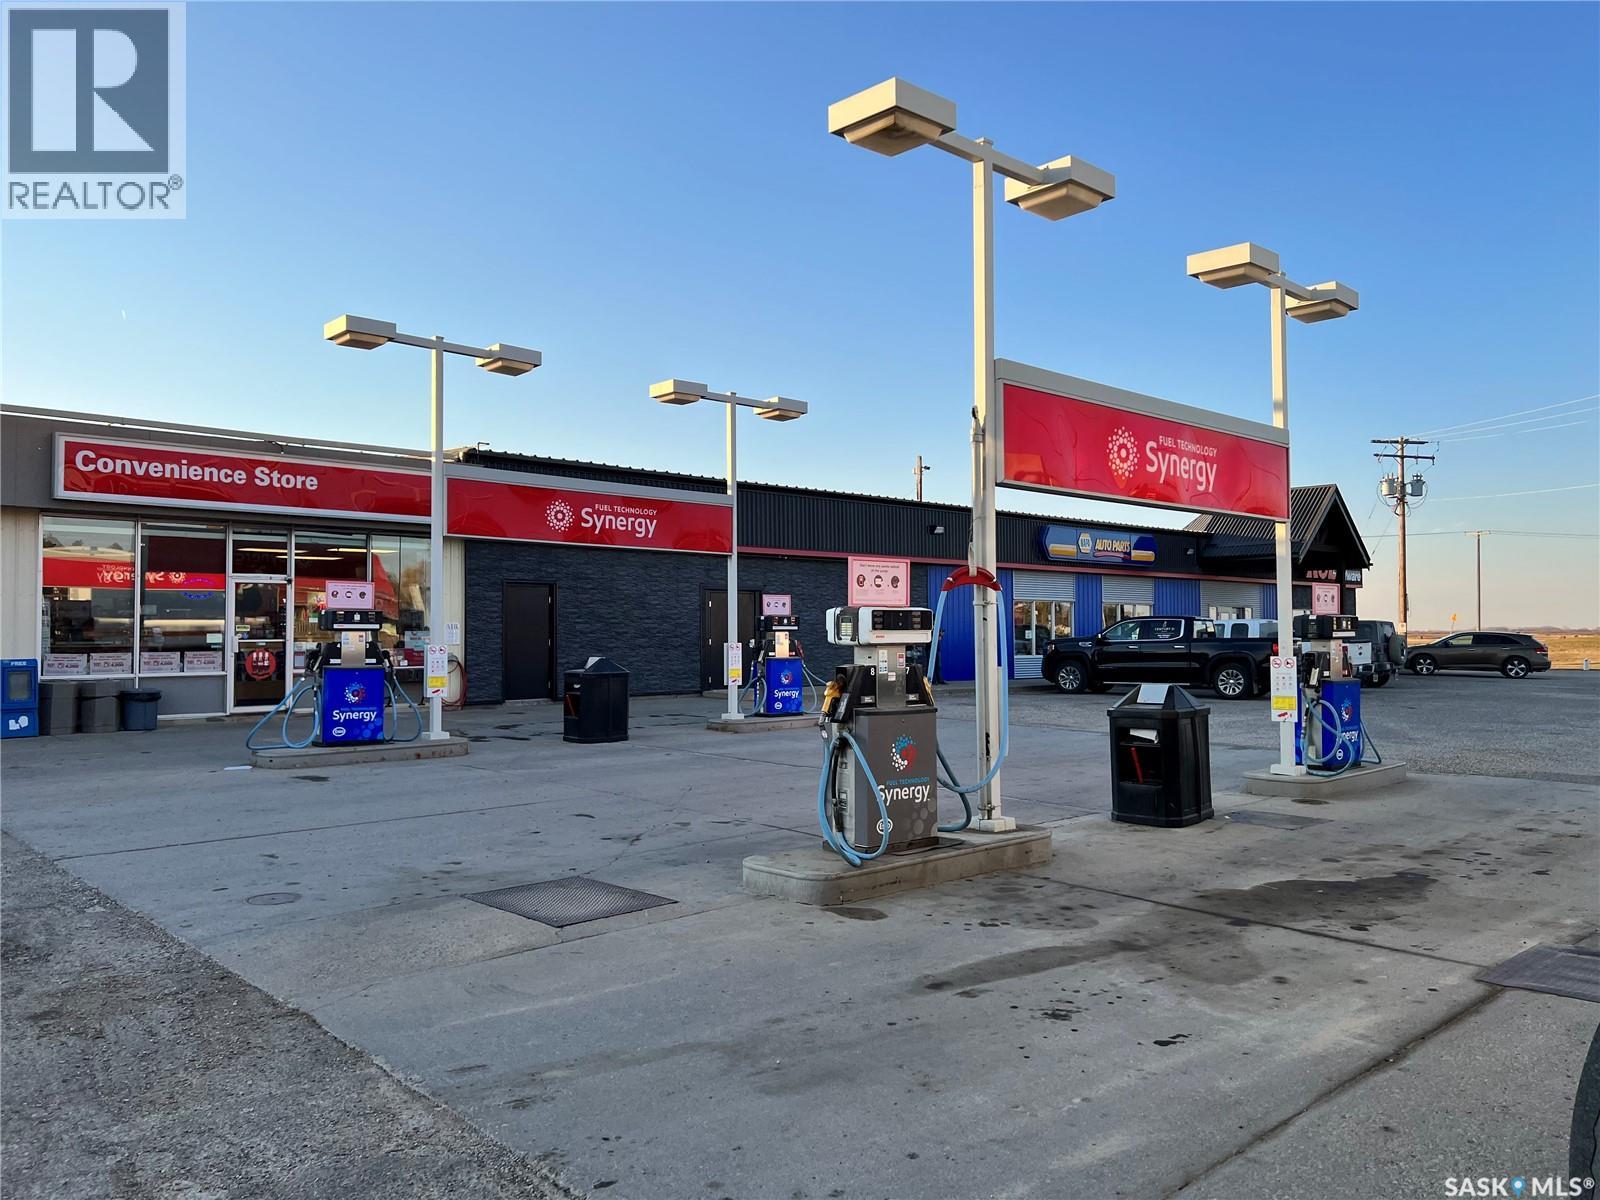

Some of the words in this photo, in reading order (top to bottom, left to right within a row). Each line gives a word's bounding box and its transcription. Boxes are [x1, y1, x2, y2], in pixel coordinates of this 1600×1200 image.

[1159, 435, 1176, 448] FUEL
[1177, 439, 1217, 457] TECHNOLOGY
[75, 450, 247, 485] Convenience
[254, 466, 318, 490] Store
[1146, 440, 1217, 493] Synergy
[595, 503, 612, 512] FUEL
[614, 505, 657, 516] TECHNOLOGY
[581, 507, 657, 538] Synergy
[1095, 538, 1112, 551] AUTO
[1112, 539, 1130, 552] PARTS
[870, 668, 875, 676] 8
[774, 690, 800, 699] Synergy
[332, 710, 377, 723] Synergy
[878, 784, 930, 806] Synergy
